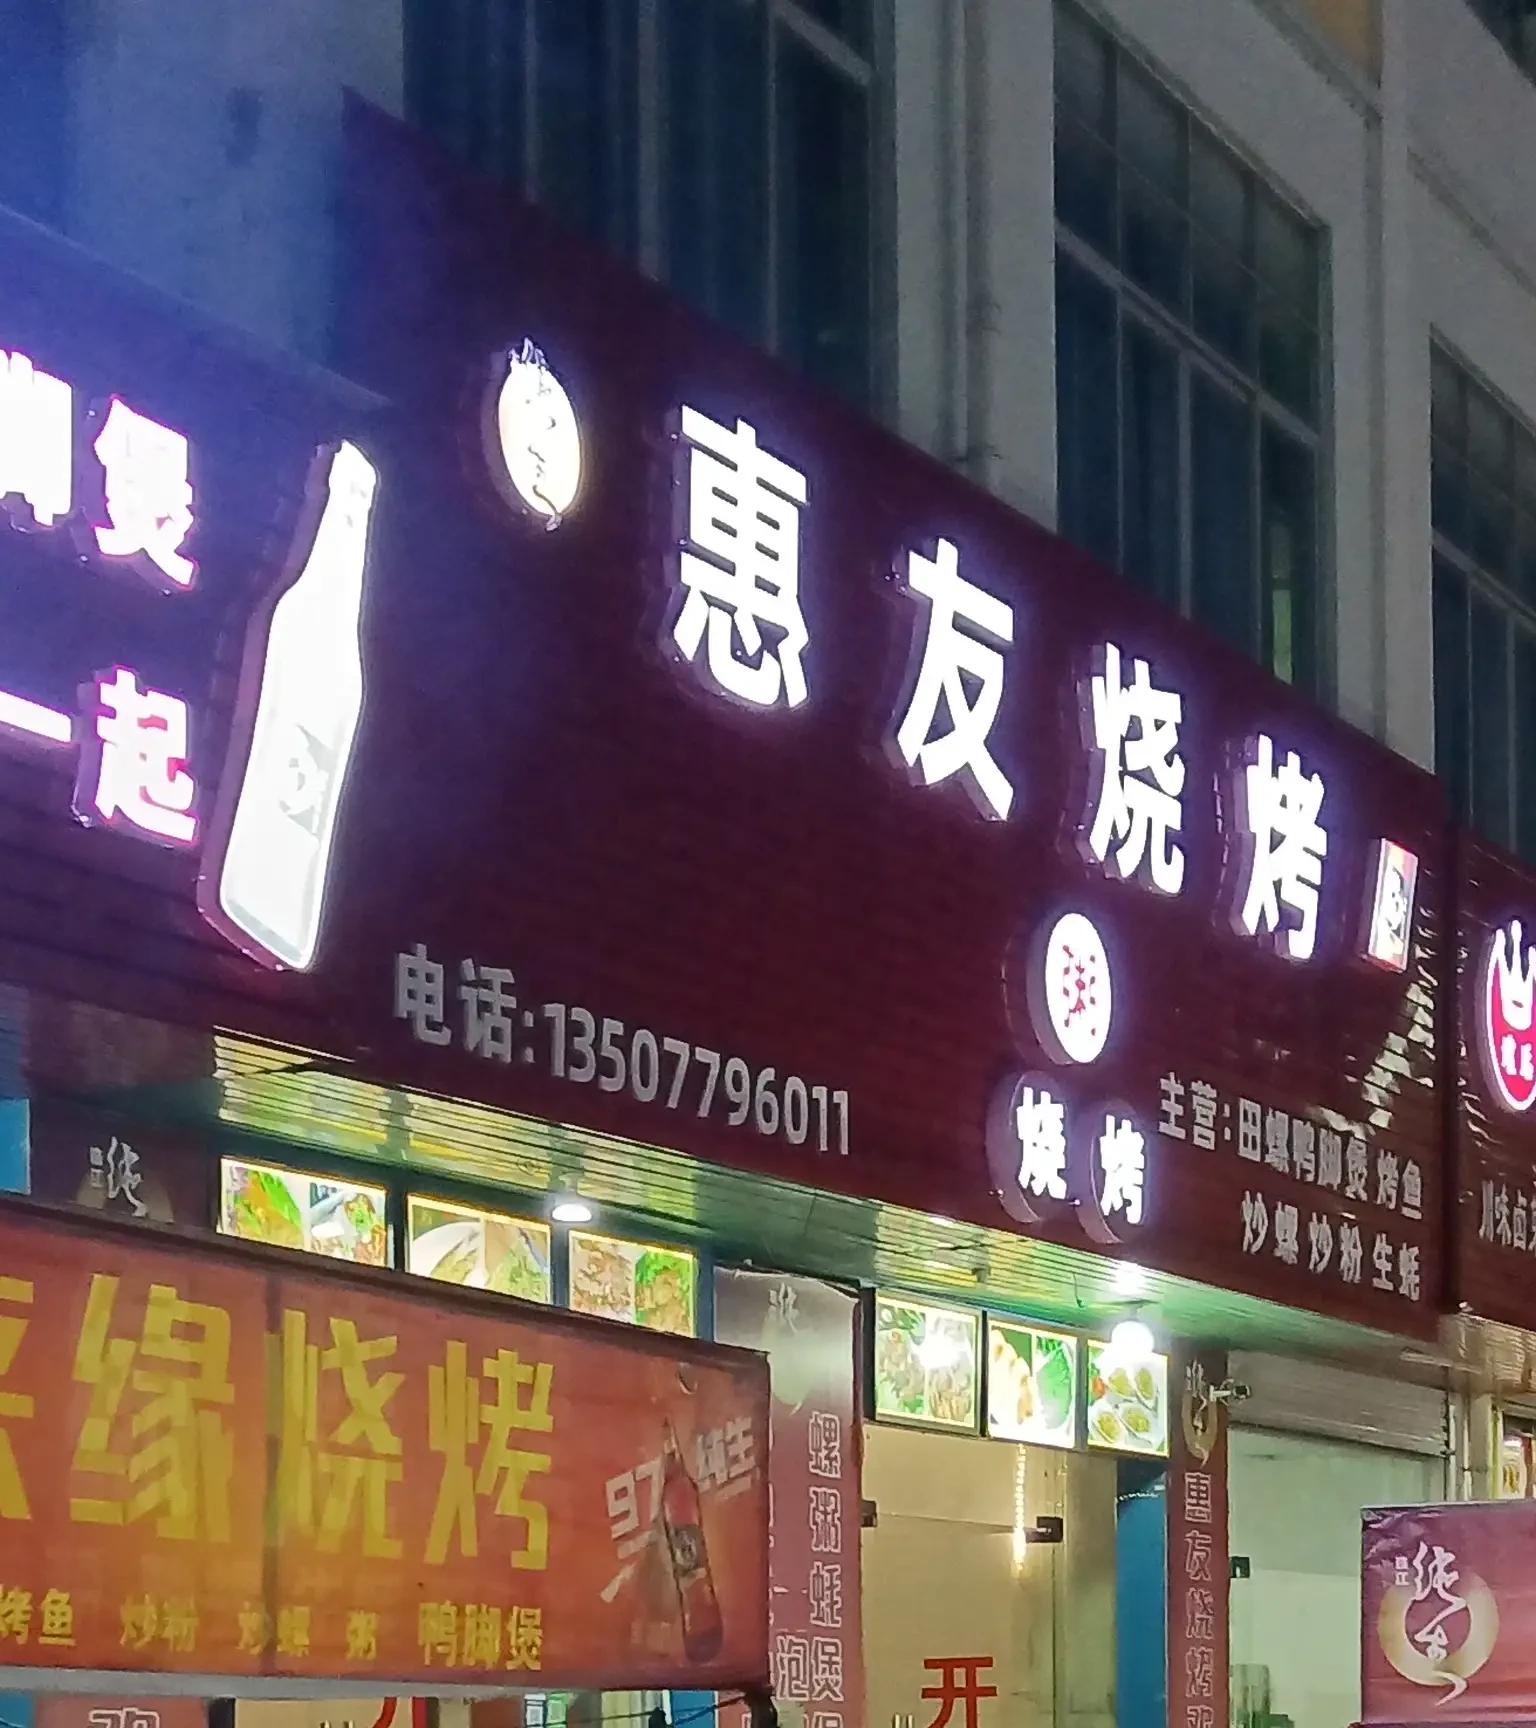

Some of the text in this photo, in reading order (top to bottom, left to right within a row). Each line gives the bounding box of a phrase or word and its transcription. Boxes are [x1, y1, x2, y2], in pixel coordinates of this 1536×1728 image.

[674, 402, 1328, 962] 惠友烧烤
[1016, 1086, 1146, 1226] 烧烤
[417, 1602, 543, 1672] 鸭脚煲
